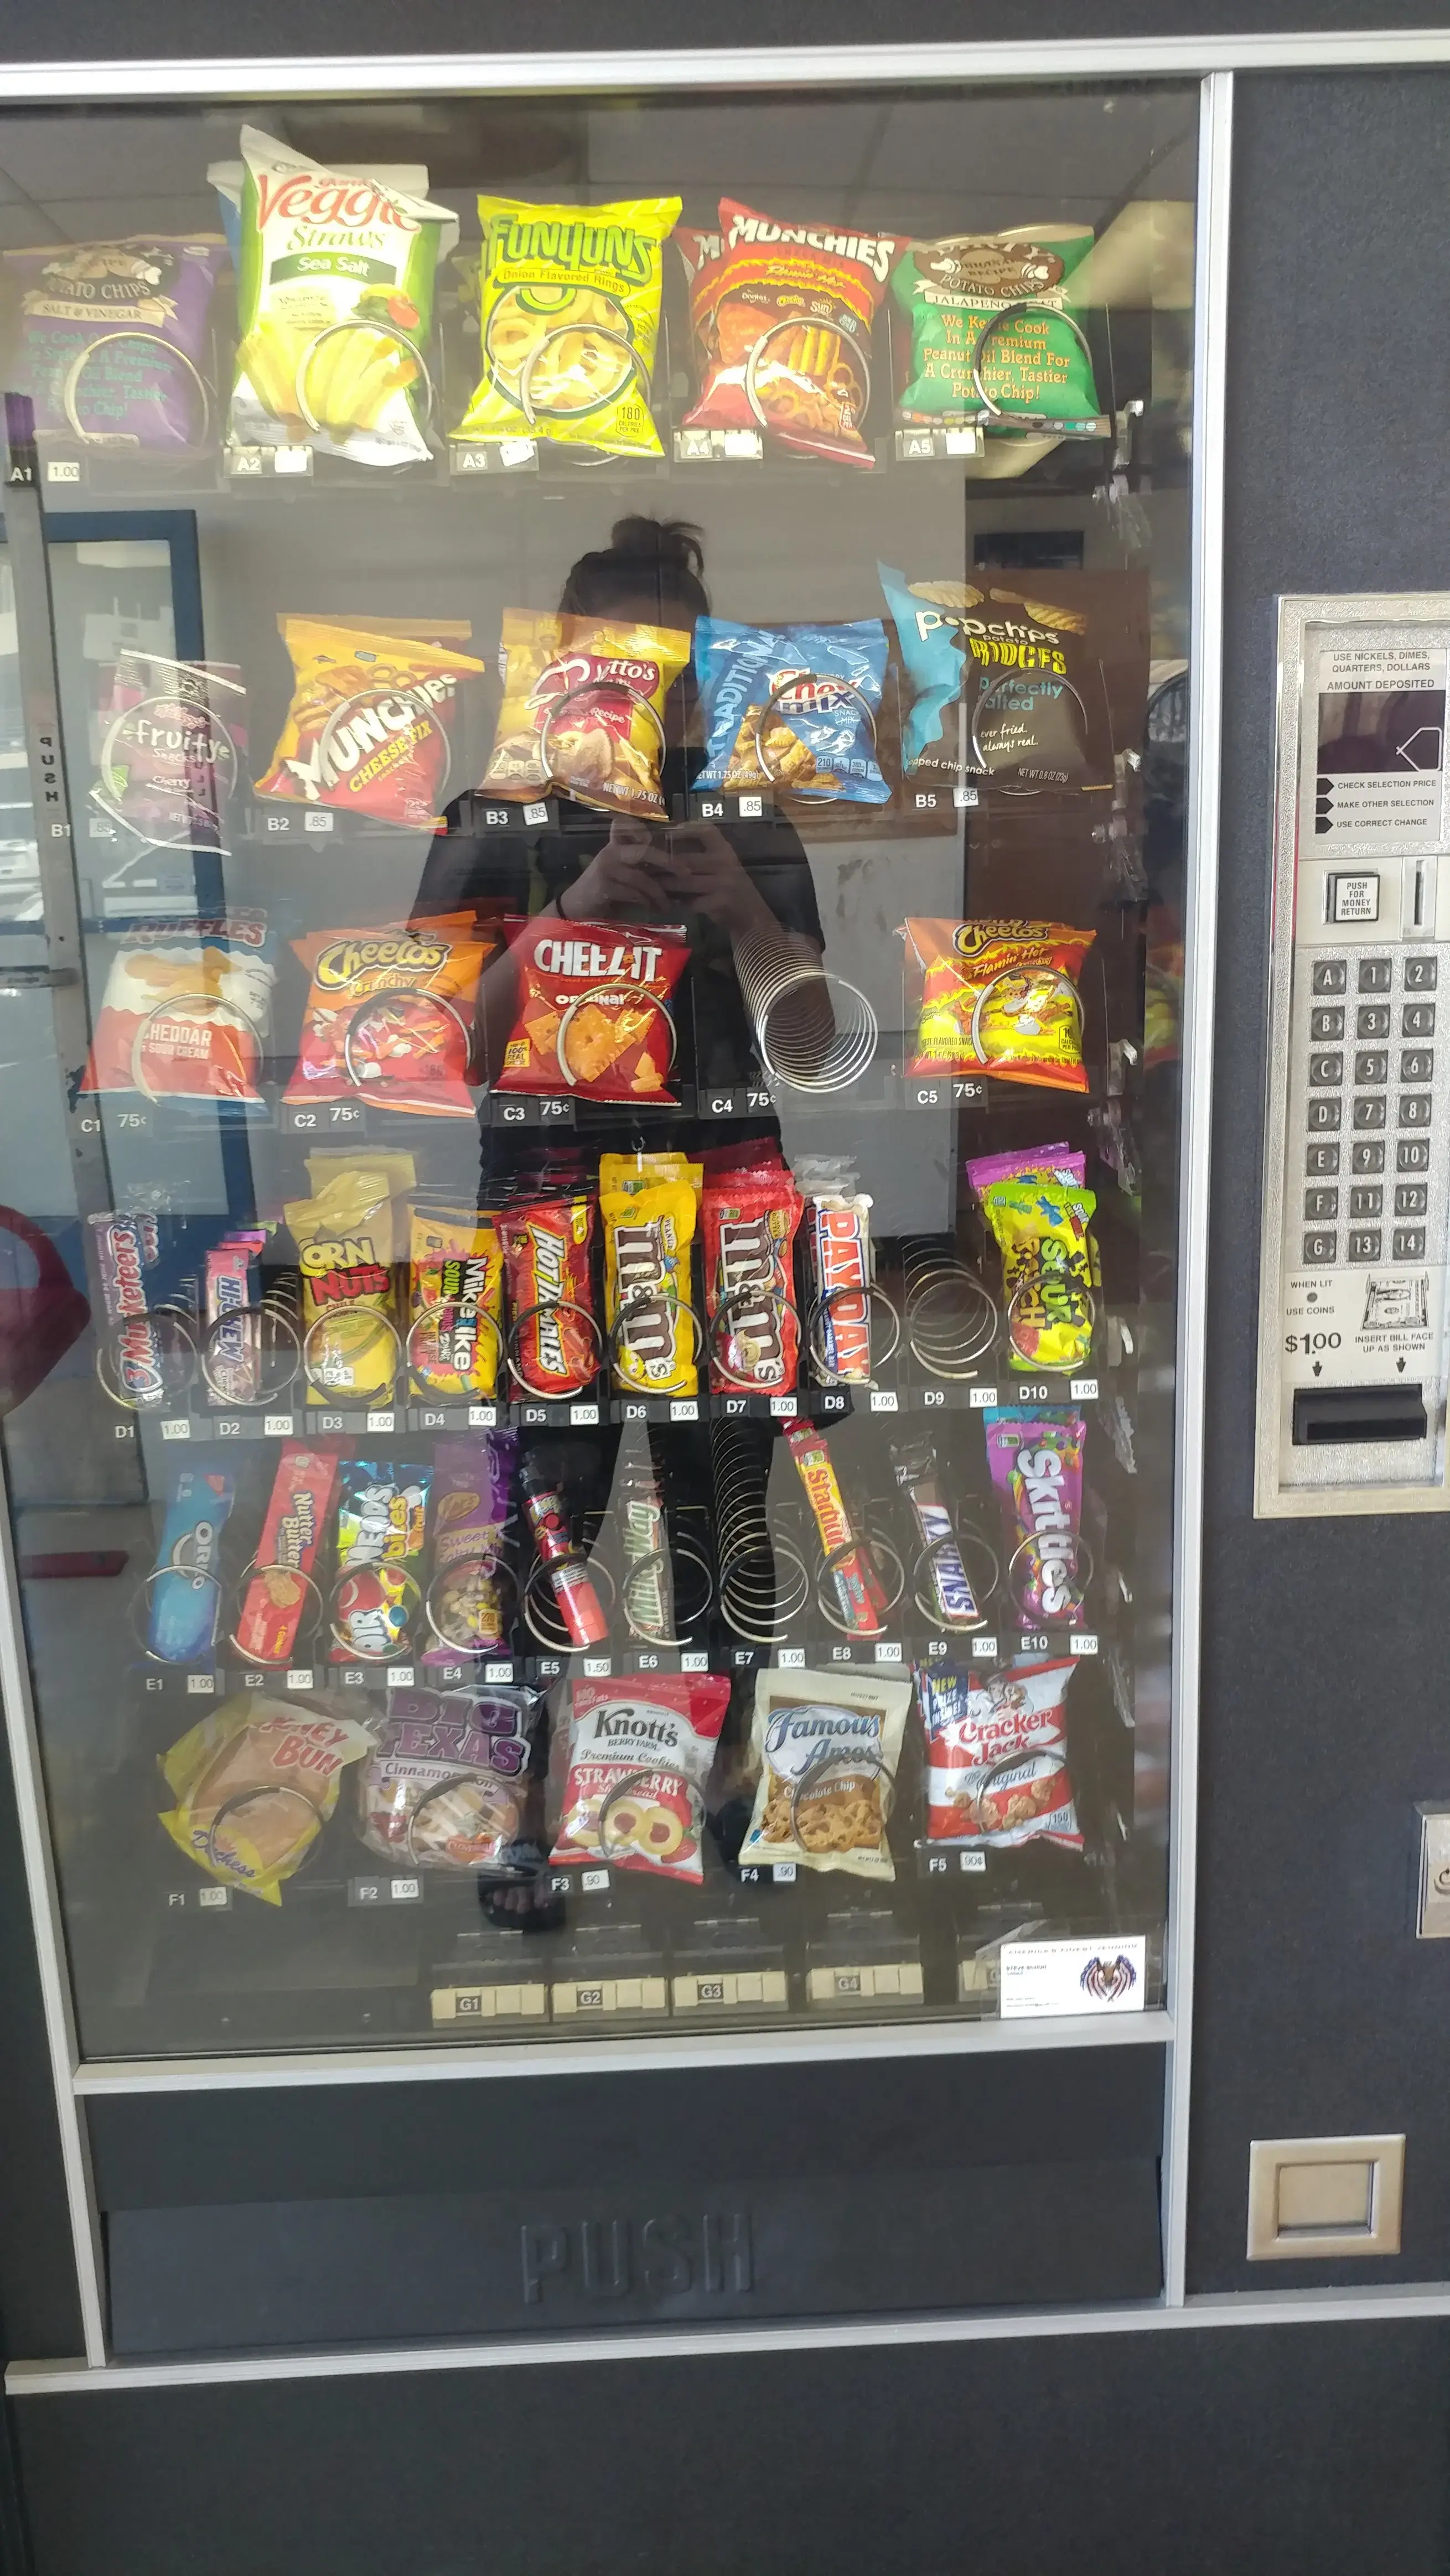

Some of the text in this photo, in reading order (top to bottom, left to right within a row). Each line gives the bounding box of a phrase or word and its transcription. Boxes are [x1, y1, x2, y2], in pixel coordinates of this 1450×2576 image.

[488, 212, 657, 287] FUNYUNS
[728, 215, 895, 283] MUNCHIES
[297, 256, 371, 277] Sea Salt
[502, 269, 626, 294] Onion Flavored Rings
[939, 274, 1046, 298] POTATO CHIPS
[941, 314, 1050, 335] We Cook
[946, 329, 960, 344] In
[923, 348, 1070, 368] Peanut Blend For
[924, 363, 1068, 383] A Tastier
[1000, 384, 1040, 404] Chip!
[687, 441, 710, 456] A4
[908, 439, 931, 455] A5
[237, 458, 261, 472] A2
[463, 452, 486, 469] A3
[11, 466, 33, 481] A1
[969, 637, 1067, 675] RIDGES
[1333, 651, 1430, 661] USE NICKELS, DIMES,
[1332, 662, 1430, 673] QUARTERS, DOLLARS
[1327, 679, 1435, 690] AMOUNT DEPOSITED
[589, 707, 626, 724] Recipe
[408, 720, 433, 745] FIX
[999, 723, 1029, 740] fried.
[133, 719, 221, 764] fruity
[982, 735, 1040, 753] always real.
[349, 738, 409, 793] CHEESE
[940, 760, 995, 776] chip snack
[1338, 781, 1365, 790] CHECK
[1367, 780, 1411, 788] SELECTION
[915, 790, 977, 808] B5 .85
[1337, 801, 1360, 809] MAKE
[1390, 799, 1435, 807] SELECTION
[485, 807, 546, 825] B3 .85
[702, 800, 762, 817] B4 .85
[51, 824, 72, 838] B1
[267, 817, 291, 832] B2
[1337, 820, 1353, 828] USE
[1354, 819, 1392, 827] CORRECT
[1346, 881, 1368, 890] PUSH
[1340, 907, 1371, 916] RETURN
[1342, 899, 1371, 907] MONEY
[952, 922, 1049, 958] Cheetos
[1021, 947, 1050, 960] Hot
[313, 939, 454, 991] Cheetos
[1323, 965, 1423, 986] A 1 2
[1322, 1011, 1421, 1032] B 3 4
[148, 1041, 210, 1060] SOUR CREAM
[1320, 1056, 1419, 1078] C 5 6
[916, 1084, 983, 1104] C5 75¢
[503, 1101, 571, 1121] C3 75¢
[711, 1093, 778, 1114] C4 75¢
[294, 1107, 361, 1128] C2 75¢
[1318, 1102, 1417, 1123] D 7 8
[81, 1114, 147, 1134] C1 75¢
[1317, 1146, 1420, 1168] E 9 10
[1316, 1190, 1418, 1212] F 11 12
[1313, 1234, 1416, 1256] G 13 14
[310, 1266, 391, 1306] NUTS
[442, 1260, 461, 1296] SOUR
[1290, 1280, 1318, 1289] WHEN
[1286, 1306, 1335, 1316] USE COINS
[1284, 1332, 1342, 1355] $1.00
[1354, 1332, 1434, 1344] INSERT BILL FACE
[1363, 1345, 1375, 1353] UP
[1392, 1343, 1426, 1352] SHOWN
[924, 1391, 945, 1406] D9
[1019, 1383, 1098, 1400] D10 1.00
[726, 1400, 748, 1414] D7
[824, 1395, 846, 1410] D8
[424, 1411, 446, 1426] D4
[526, 1408, 547, 1423] D5
[626, 1405, 696, 1420] D6 1.00
[322, 1415, 393, 1430] D3 1.00
[293, 1492, 315, 1547] Nutter
[1016, 1448, 1075, 1614] Skittles
[928, 1641, 948, 1655] E9
[1021, 1635, 1049, 1650] E10
[639, 1656, 659, 1669] E6
[735, 1651, 754, 1665] E7
[443, 1667, 463, 1680] E4
[540, 1662, 609, 1675] E5 1.50
[344, 1671, 365, 1685] E3
[932, 1675, 957, 1695] NEW
[593, 1707, 679, 1748] Knott's
[764, 1709, 881, 1754] Famous
[958, 1708, 1053, 1744] Cracker
[376, 1721, 527, 1778] TEXAS
[607, 1737, 659, 1750] BERRY FARM
[973, 1734, 1030, 1767] Jack
[271, 1734, 345, 1777] BUN
[580, 1748, 635, 1763] Premium
[790, 1738, 879, 1776] Amos
[740, 1868, 759, 1882] F4
[551, 1877, 571, 1892] F3
[701, 1984, 722, 1998] G3
[837, 1977, 859, 1991] G4
[459, 1997, 480, 2011] G1
[579, 1990, 602, 2005] G2
[520, 2213, 755, 2305] PUSH
